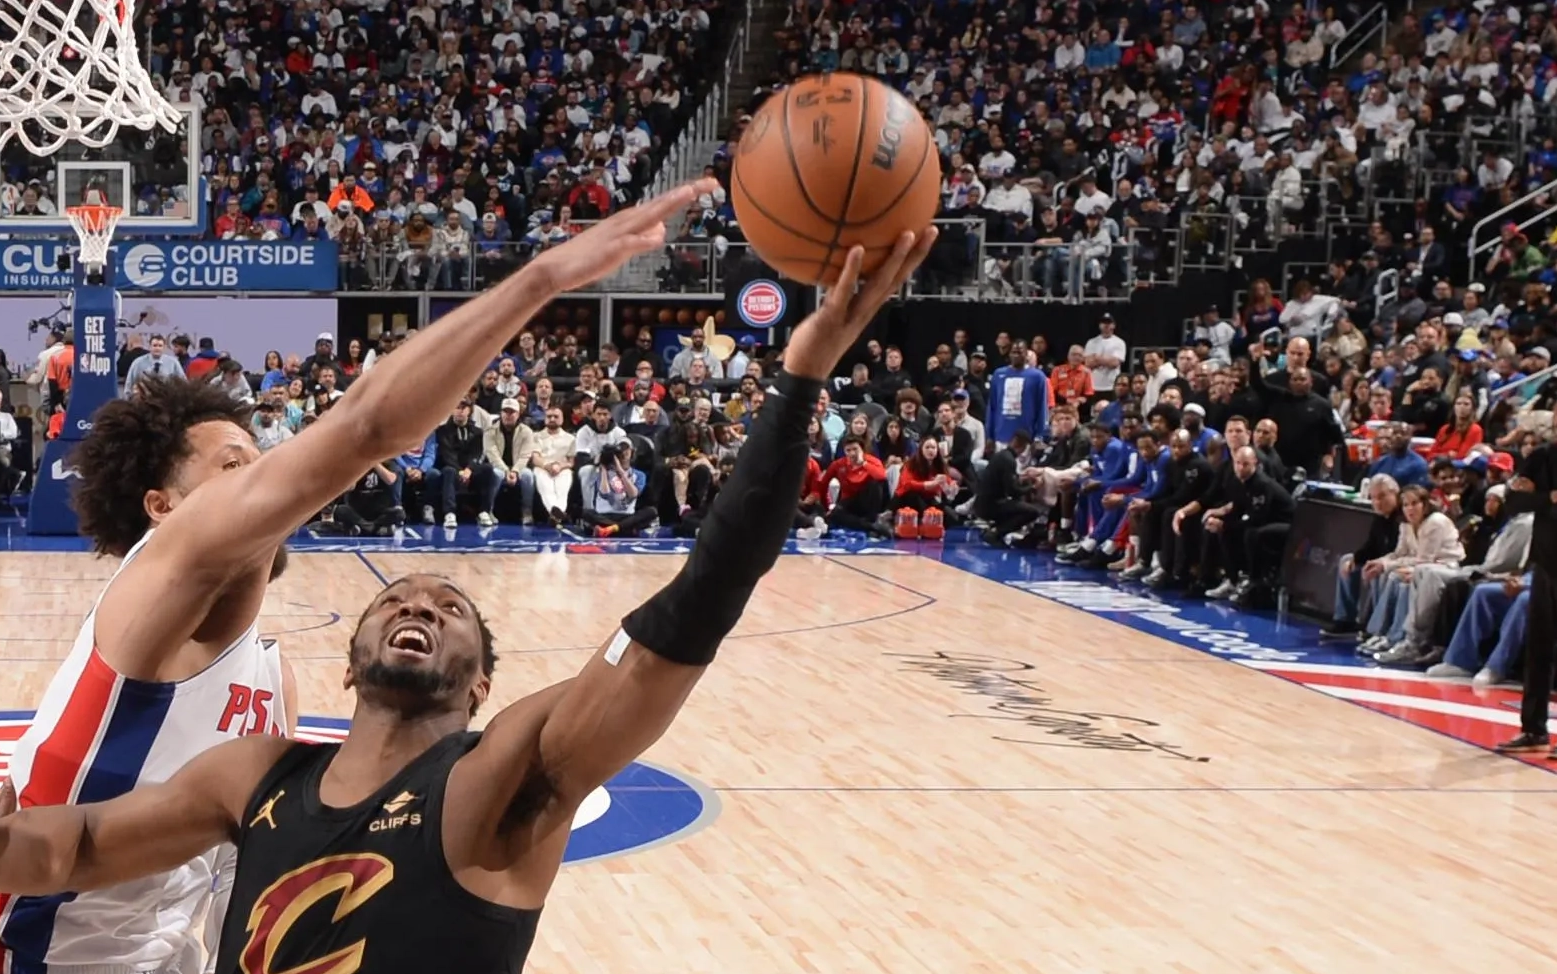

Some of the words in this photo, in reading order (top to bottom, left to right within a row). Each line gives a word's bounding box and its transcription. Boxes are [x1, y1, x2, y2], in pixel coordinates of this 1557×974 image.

[3, 244, 119, 274] CU
[171, 244, 314, 265] COURTSIDE
[4, 275, 75, 286] INSURAN
[171, 266, 239, 287] CLUB
[84, 316, 106, 334] GET
[84, 335, 106, 353] THE
[90, 354, 111, 377] App
[368, 812, 422, 833] CLIFFS
